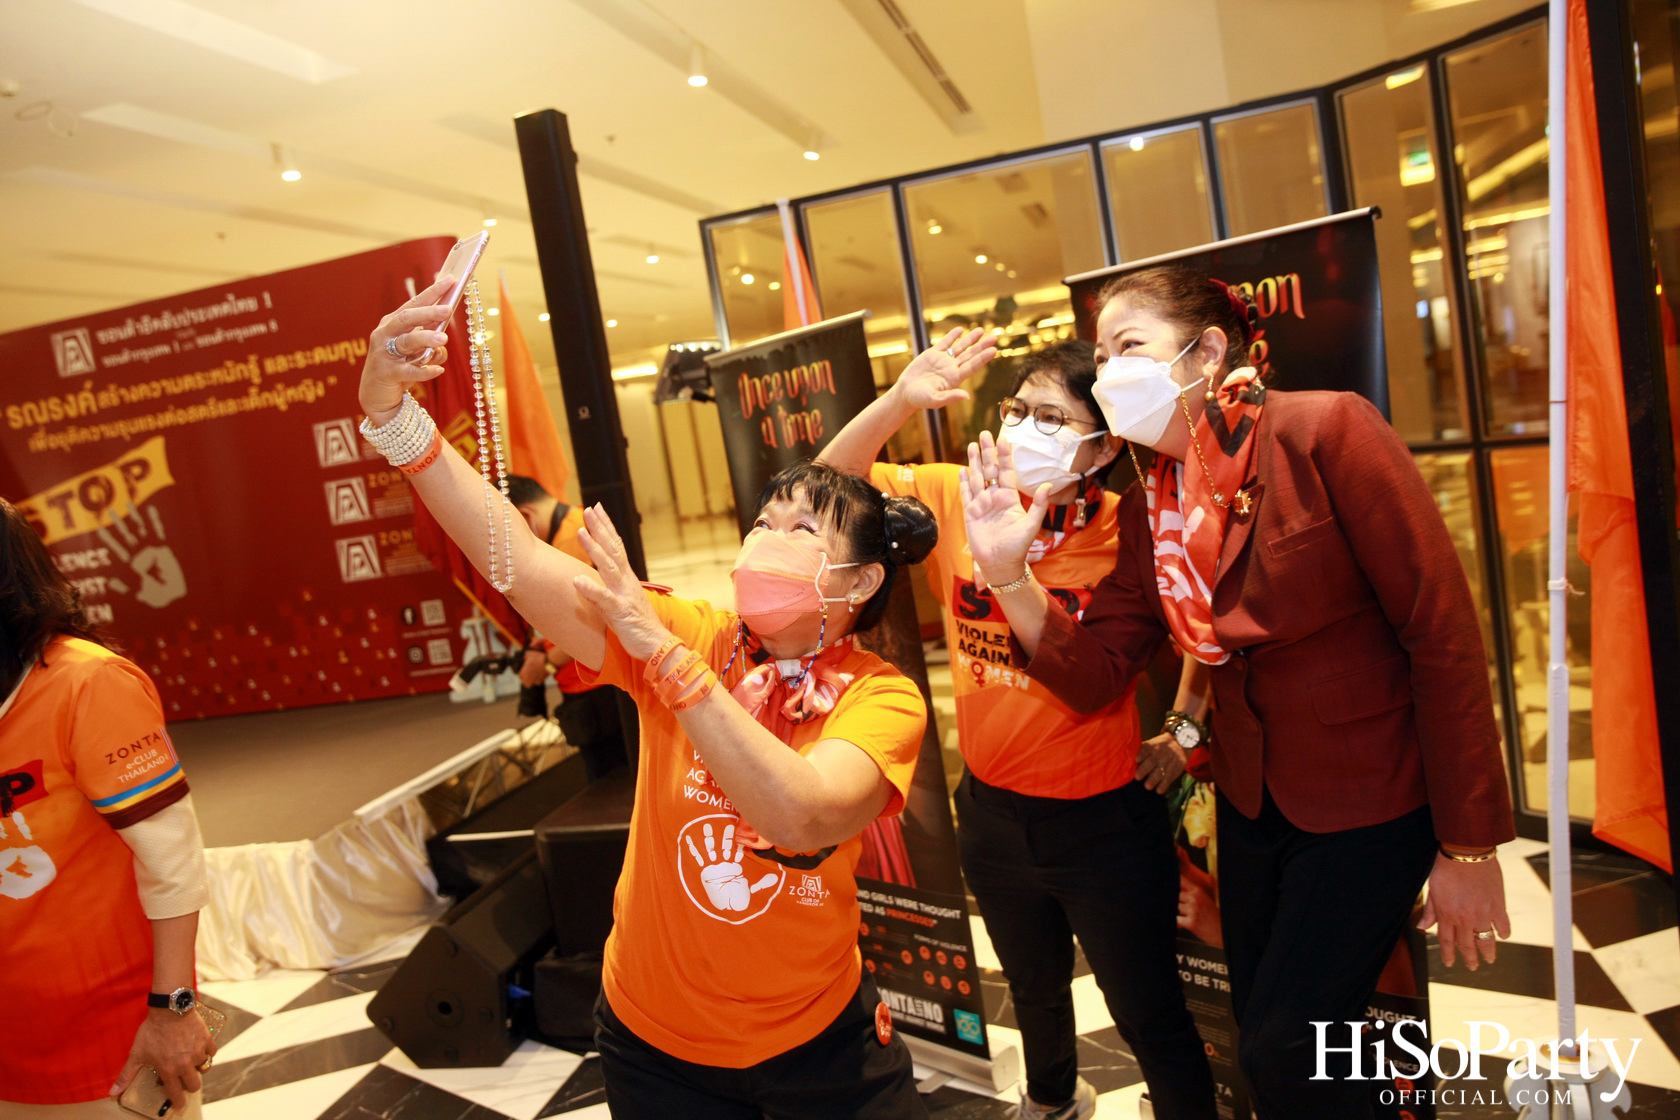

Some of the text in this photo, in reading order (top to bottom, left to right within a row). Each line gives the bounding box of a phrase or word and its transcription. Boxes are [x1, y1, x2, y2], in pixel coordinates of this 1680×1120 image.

[738, 359, 837, 420] Once upon
[777, 404, 824, 449] time
[404, 450, 438, 475] ZONTA
[958, 639, 1011, 666] AGAIN
[105, 732, 161, 765] ZONTA
[126, 749, 158, 770] e-CLUB
[789, 885, 830, 899] ZONTA
[871, 891, 894, 905] GIRLS
[894, 896, 919, 910] WERE
[918, 902, 961, 920] THOUGHT
[1194, 973, 1211, 988] BE
